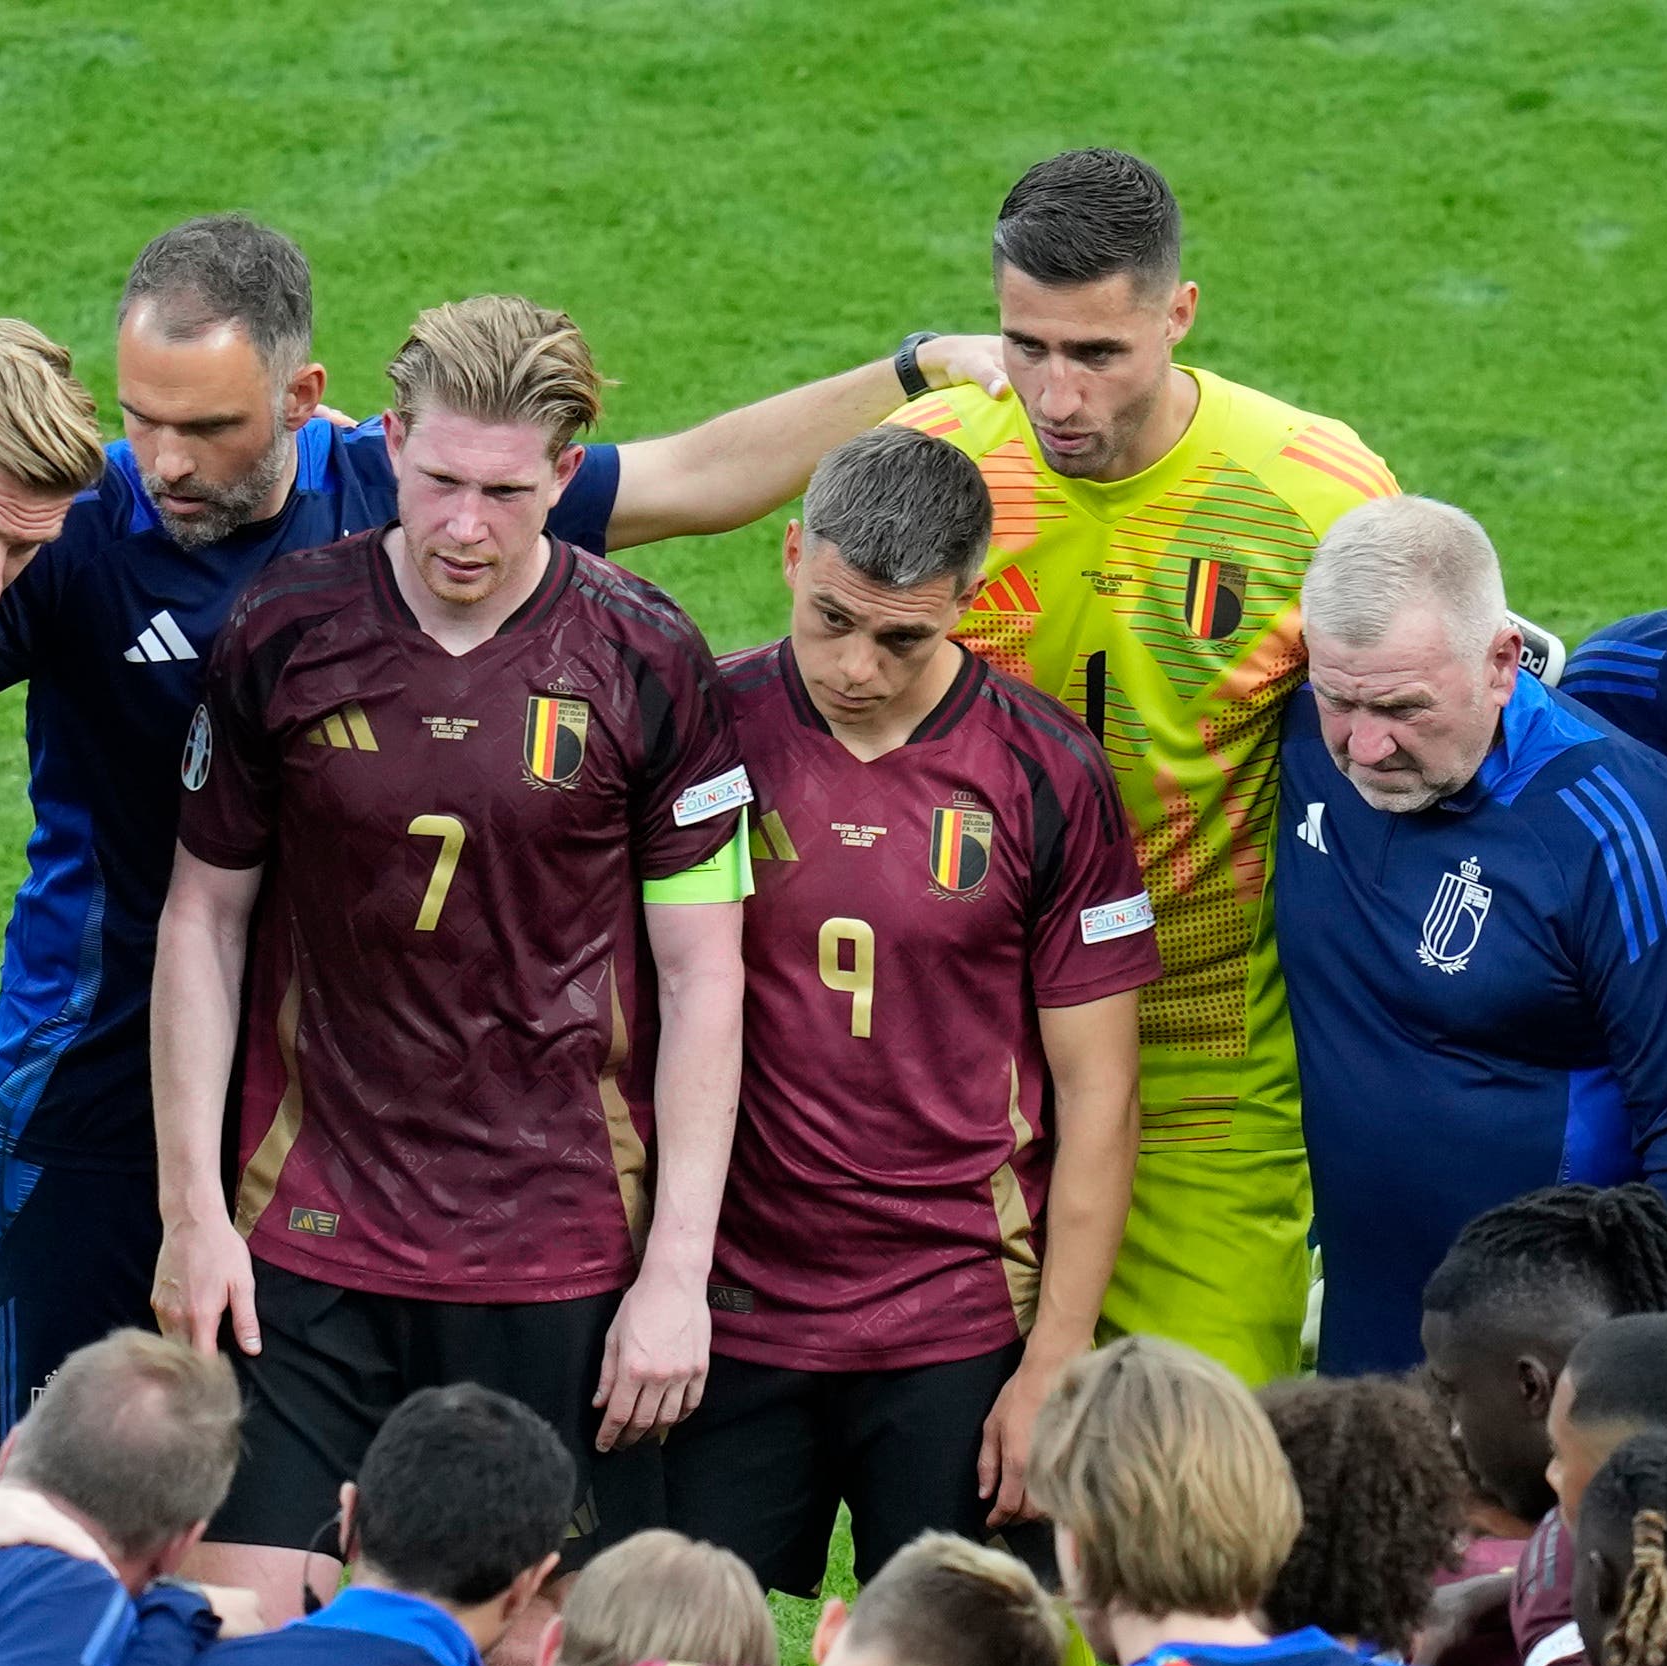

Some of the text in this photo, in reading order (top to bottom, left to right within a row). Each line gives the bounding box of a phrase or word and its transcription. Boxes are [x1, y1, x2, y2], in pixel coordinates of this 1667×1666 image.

[1086, 650, 1106, 748] 1
[405, 813, 466, 932] 7
[818, 917, 875, 1039] 9
